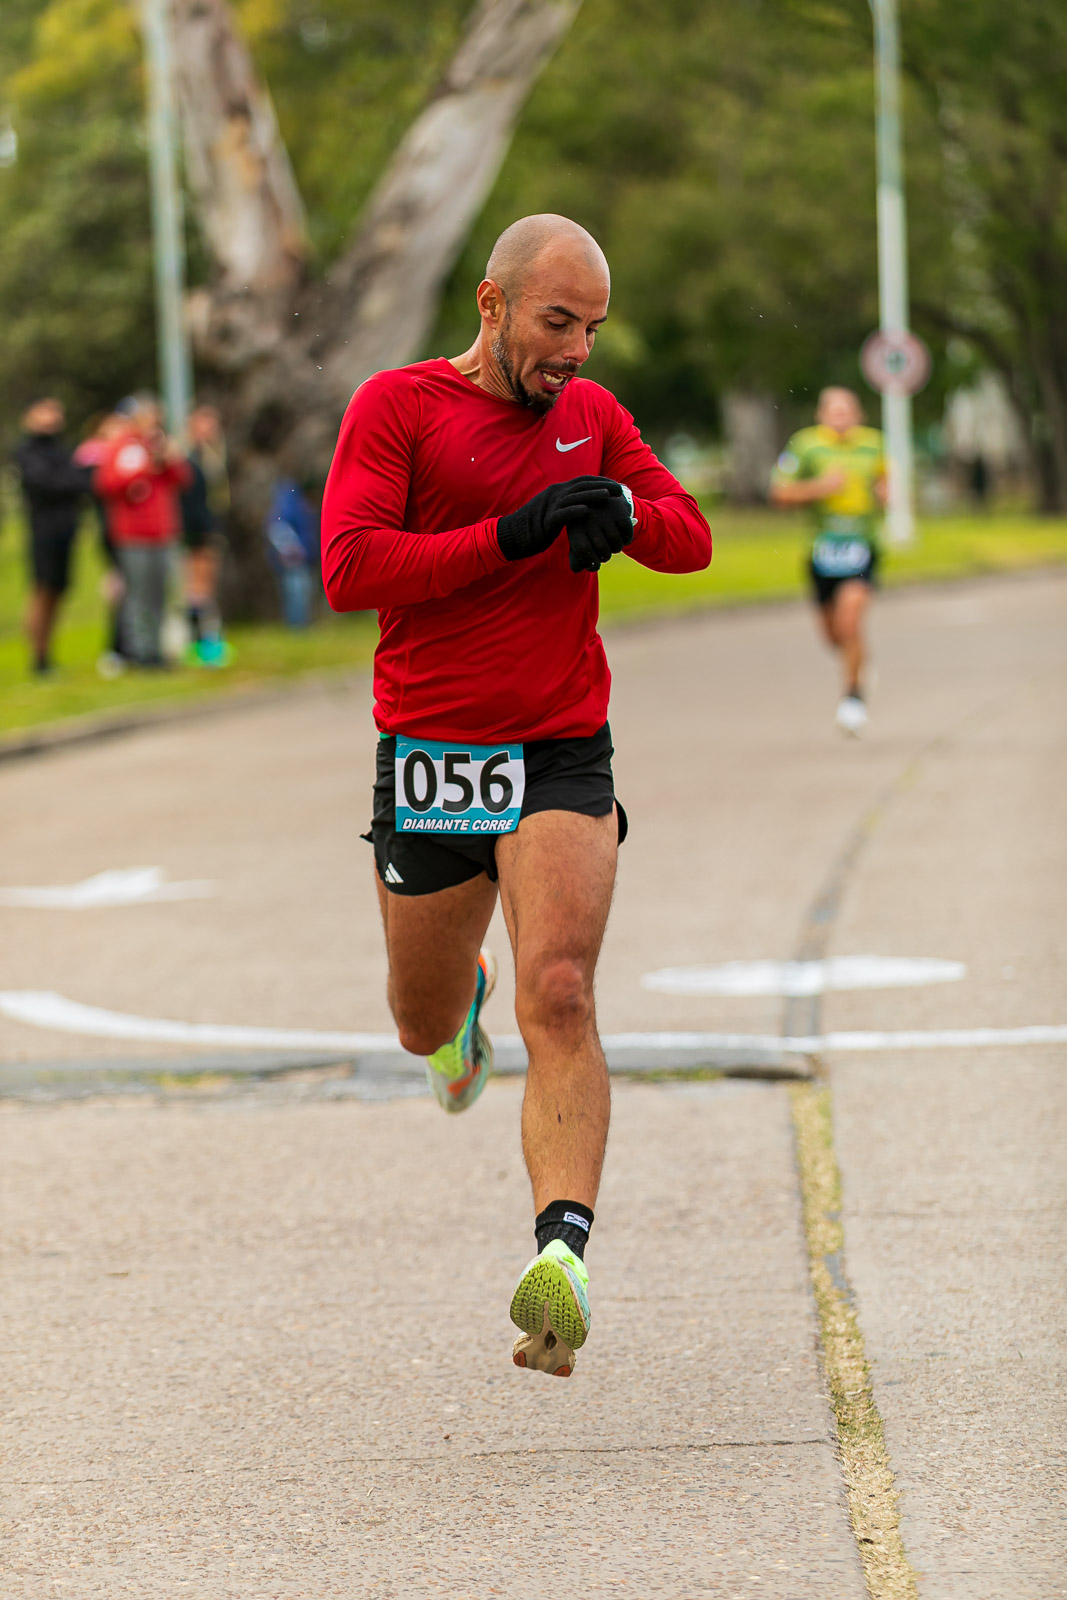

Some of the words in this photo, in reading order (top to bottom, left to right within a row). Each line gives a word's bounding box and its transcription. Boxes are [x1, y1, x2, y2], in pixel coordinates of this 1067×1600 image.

[403, 749, 513, 815] 056
[402, 818, 470, 831] DIAMANTE
[471, 818, 514, 831] CORRE
